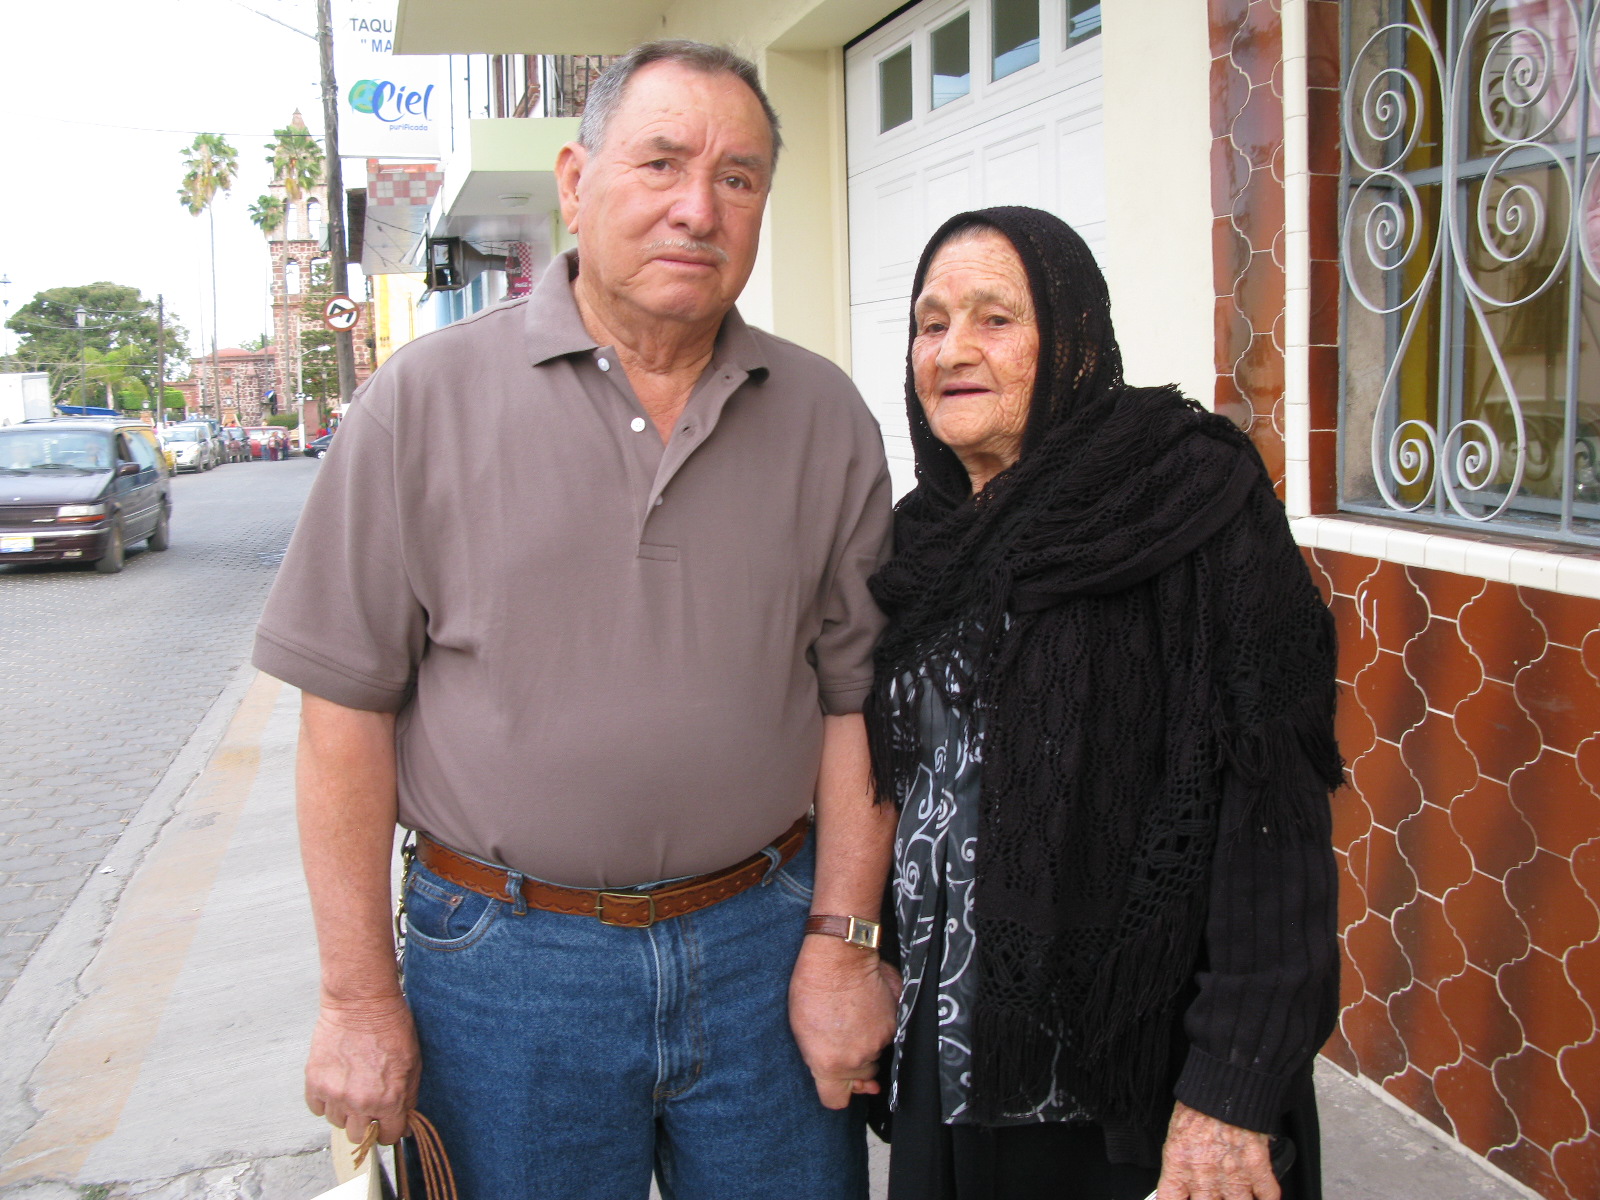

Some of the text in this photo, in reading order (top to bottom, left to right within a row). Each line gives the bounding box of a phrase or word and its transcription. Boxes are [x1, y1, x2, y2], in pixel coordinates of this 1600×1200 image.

[349, 18, 393, 33] TAQU
[372, 80, 435, 123] Ciel
[389, 124, 429, 132] purificada
